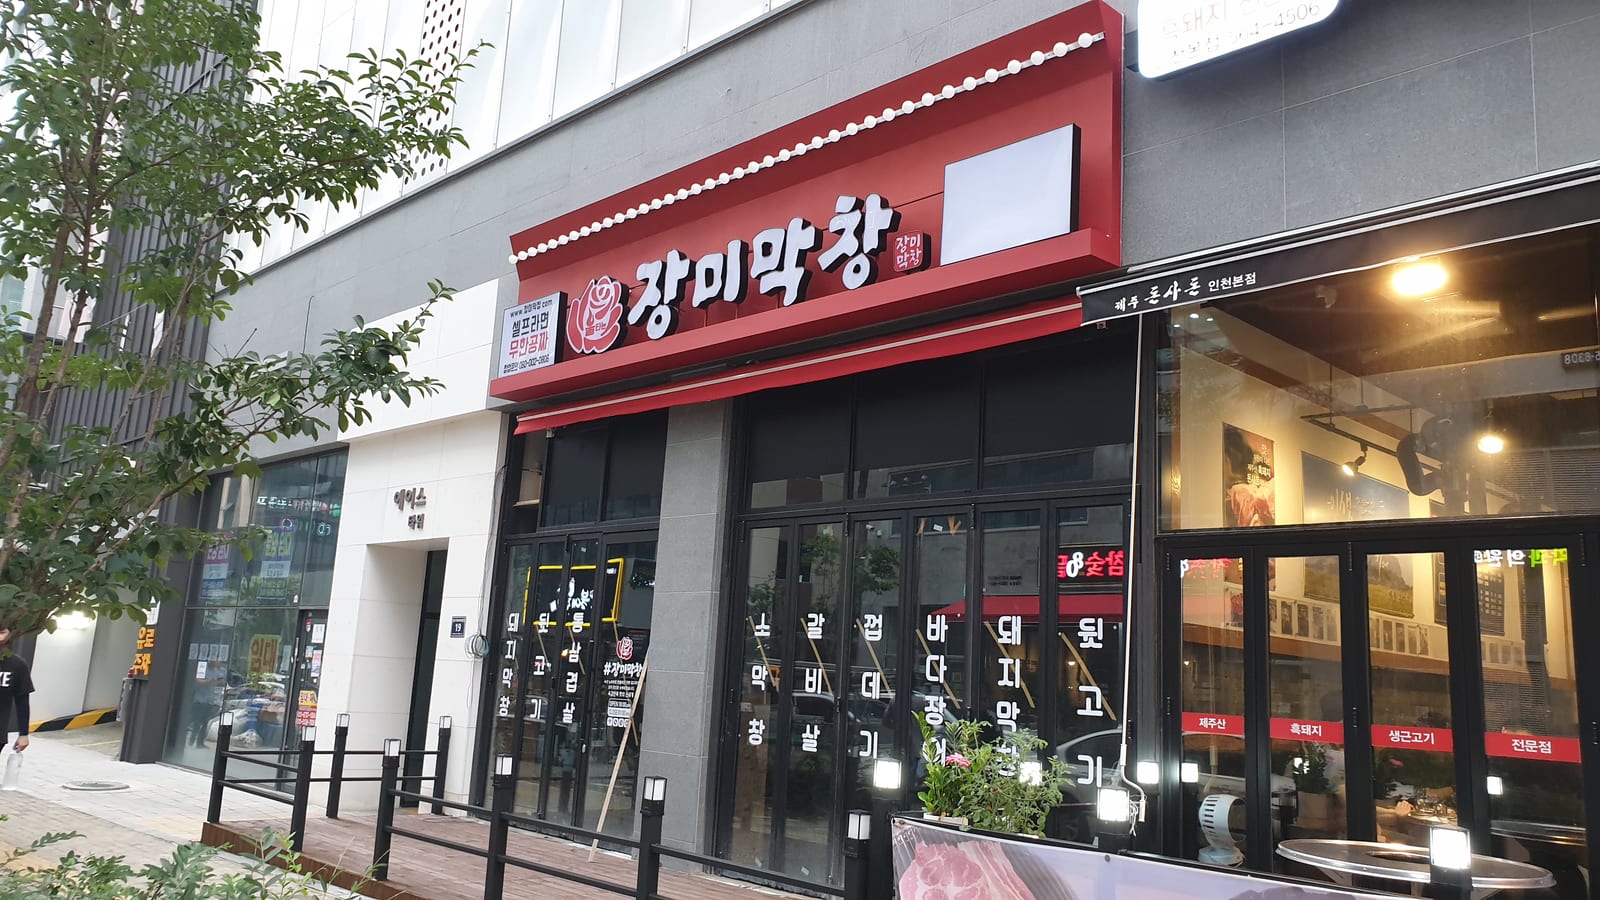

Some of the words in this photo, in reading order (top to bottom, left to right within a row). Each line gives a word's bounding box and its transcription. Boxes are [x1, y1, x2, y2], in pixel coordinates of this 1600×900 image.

[895, 233, 922, 254] 장미
[896, 248, 922, 268] 막창
[628, 193, 895, 340] 장미막창
[1114, 295, 1139, 312] 제주
[1144, 277, 1200, 304] 돈사돈
[1208, 272, 1257, 292] 인천본점
[512, 311, 549, 338] 셀프라면
[509, 330, 549, 359] 무한공짜
[394, 487, 427, 512] 에이스
[251, 638, 278, 673] 임대
[499, 612, 519, 717] 돼지막창
[562, 612, 584, 724] 통삼겹살
[748, 612, 771, 746] 소막창
[802, 613, 825, 753] 갈비살
[859, 614, 883, 759] 껍데기
[1077, 618, 1103, 788] 뒷고기
[1199, 717, 1227, 731] 제주산
[1290, 722, 1322, 737] 흑돼지
[1388, 730, 1435, 745] 생근고기
[1511, 738, 1552, 754] 전문점
